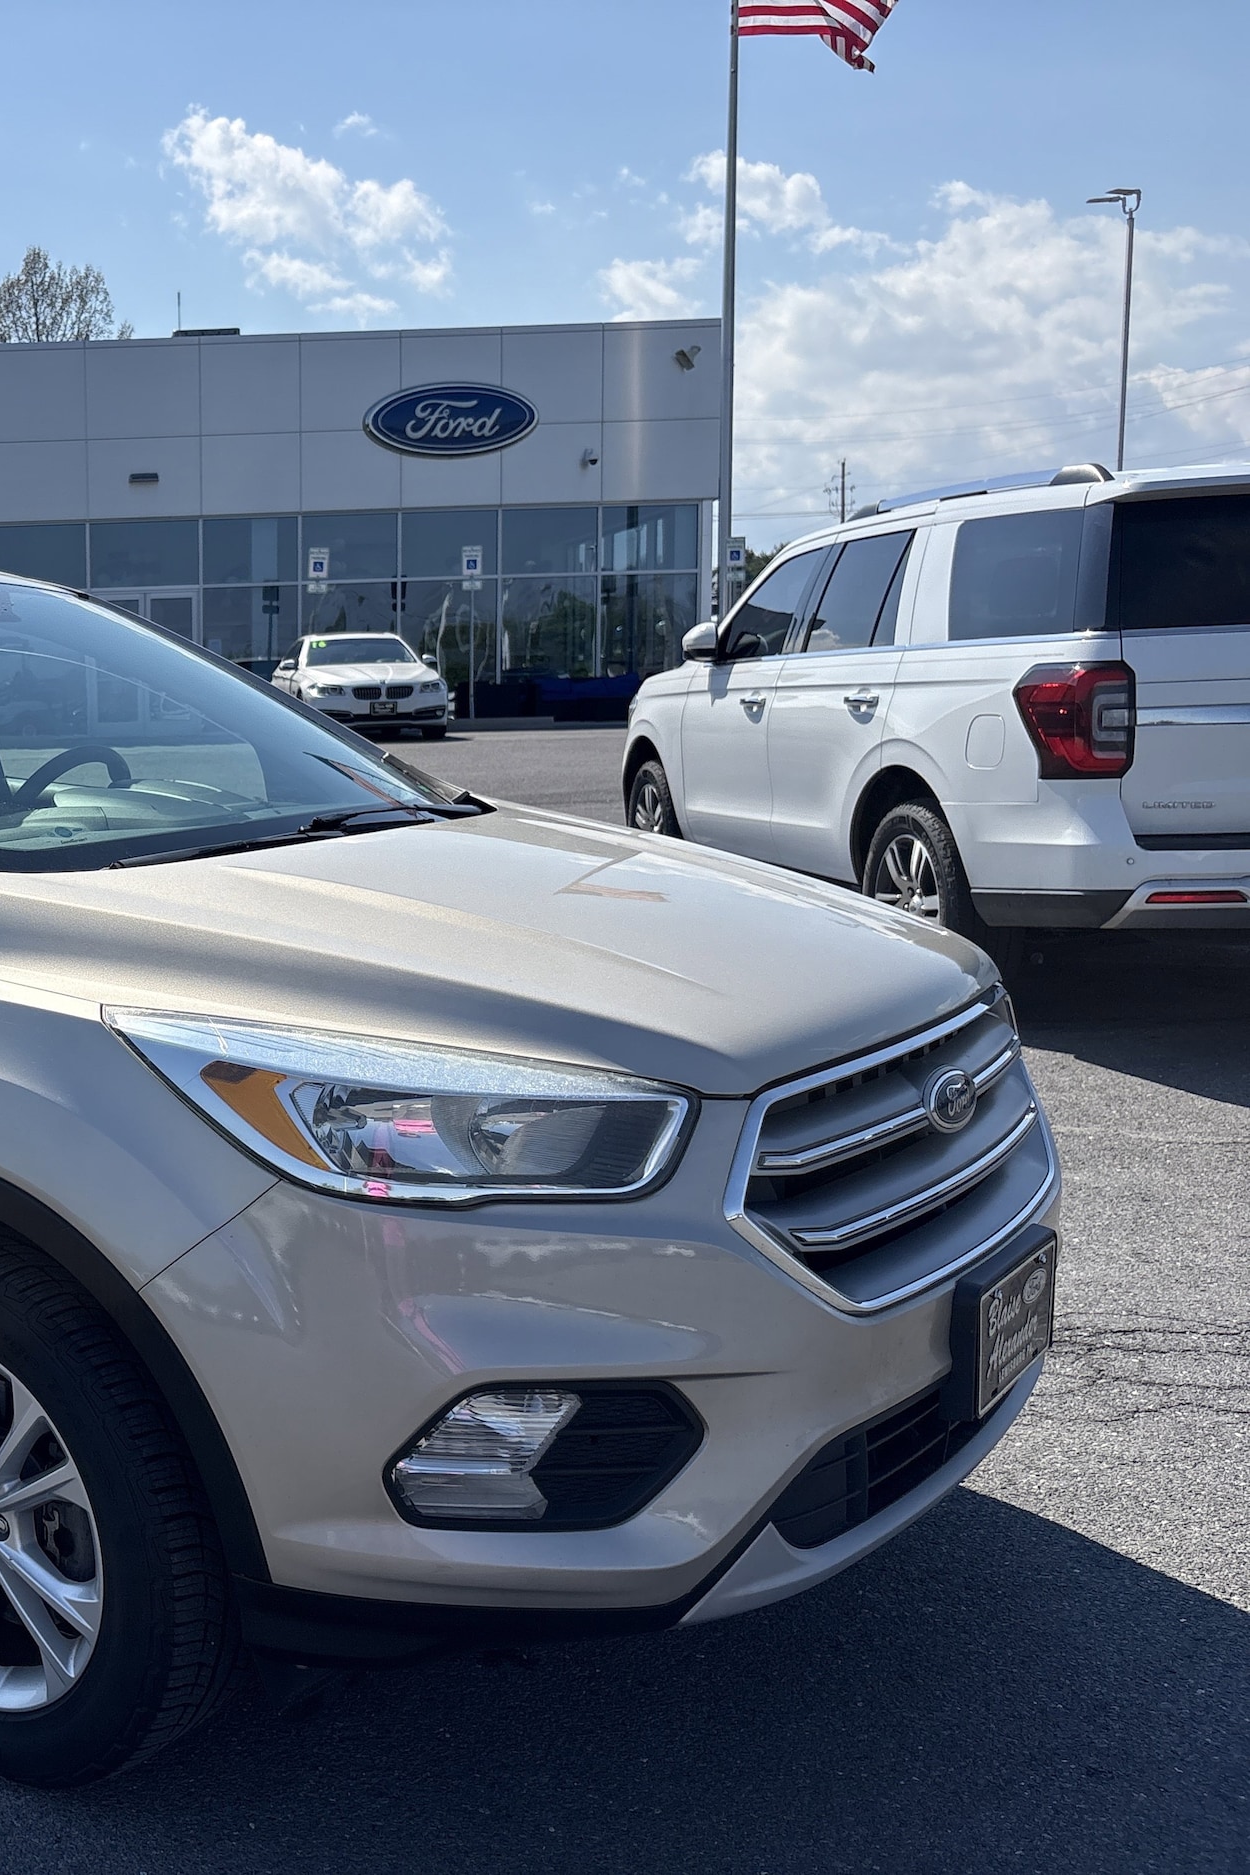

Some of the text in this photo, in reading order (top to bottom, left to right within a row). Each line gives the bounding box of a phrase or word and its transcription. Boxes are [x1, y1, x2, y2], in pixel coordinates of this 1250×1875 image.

[405, 398, 503, 440] Ford
[1141, 800, 1216, 810] LIMITED
[946, 1082, 971, 1117] Ford
[988, 1294, 1022, 1337] Blaise
[986, 1310, 1038, 1379] Alexander
